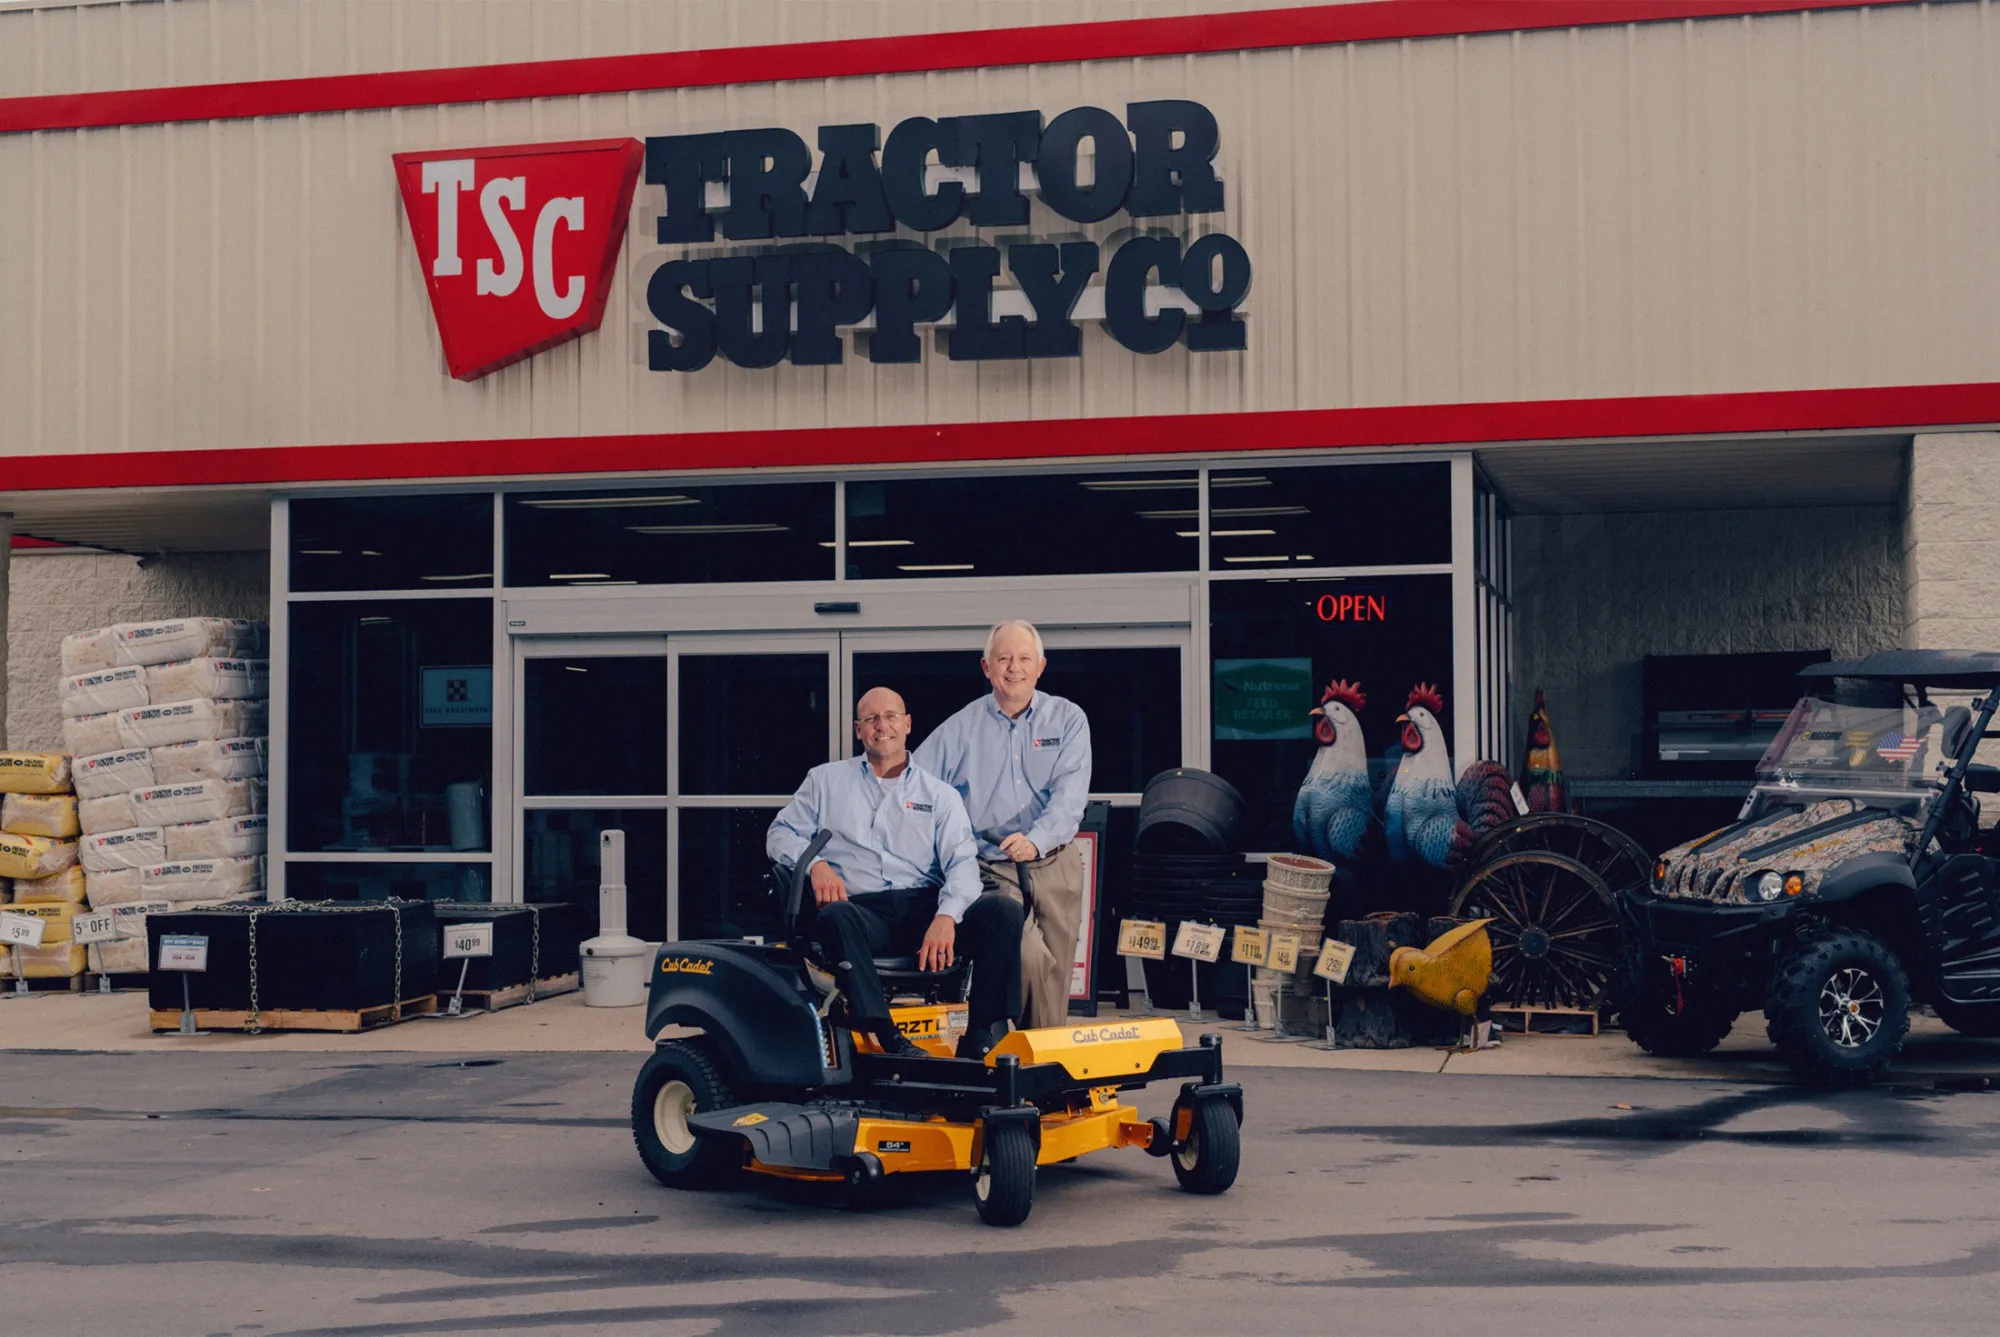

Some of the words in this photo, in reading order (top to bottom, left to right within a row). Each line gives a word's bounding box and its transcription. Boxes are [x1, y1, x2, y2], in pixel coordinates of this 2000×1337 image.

[645, 99, 1225, 244] TRACTOR
[421, 158, 586, 320] TSC
[647, 242, 1099, 372] SUPPLY
[1317, 594, 1385, 621] OPEN
[1246, 697, 1278, 708] FEED
[1233, 709, 1292, 720] RETAILER
[90, 918, 111, 933] OFF
[661, 957, 679, 973] Cub
[679, 957, 715, 975] Cadet
[896, 1019, 934, 1035] RZT
[1072, 1029, 1099, 1044] Cub
[1099, 1026, 1141, 1041] Cadet
